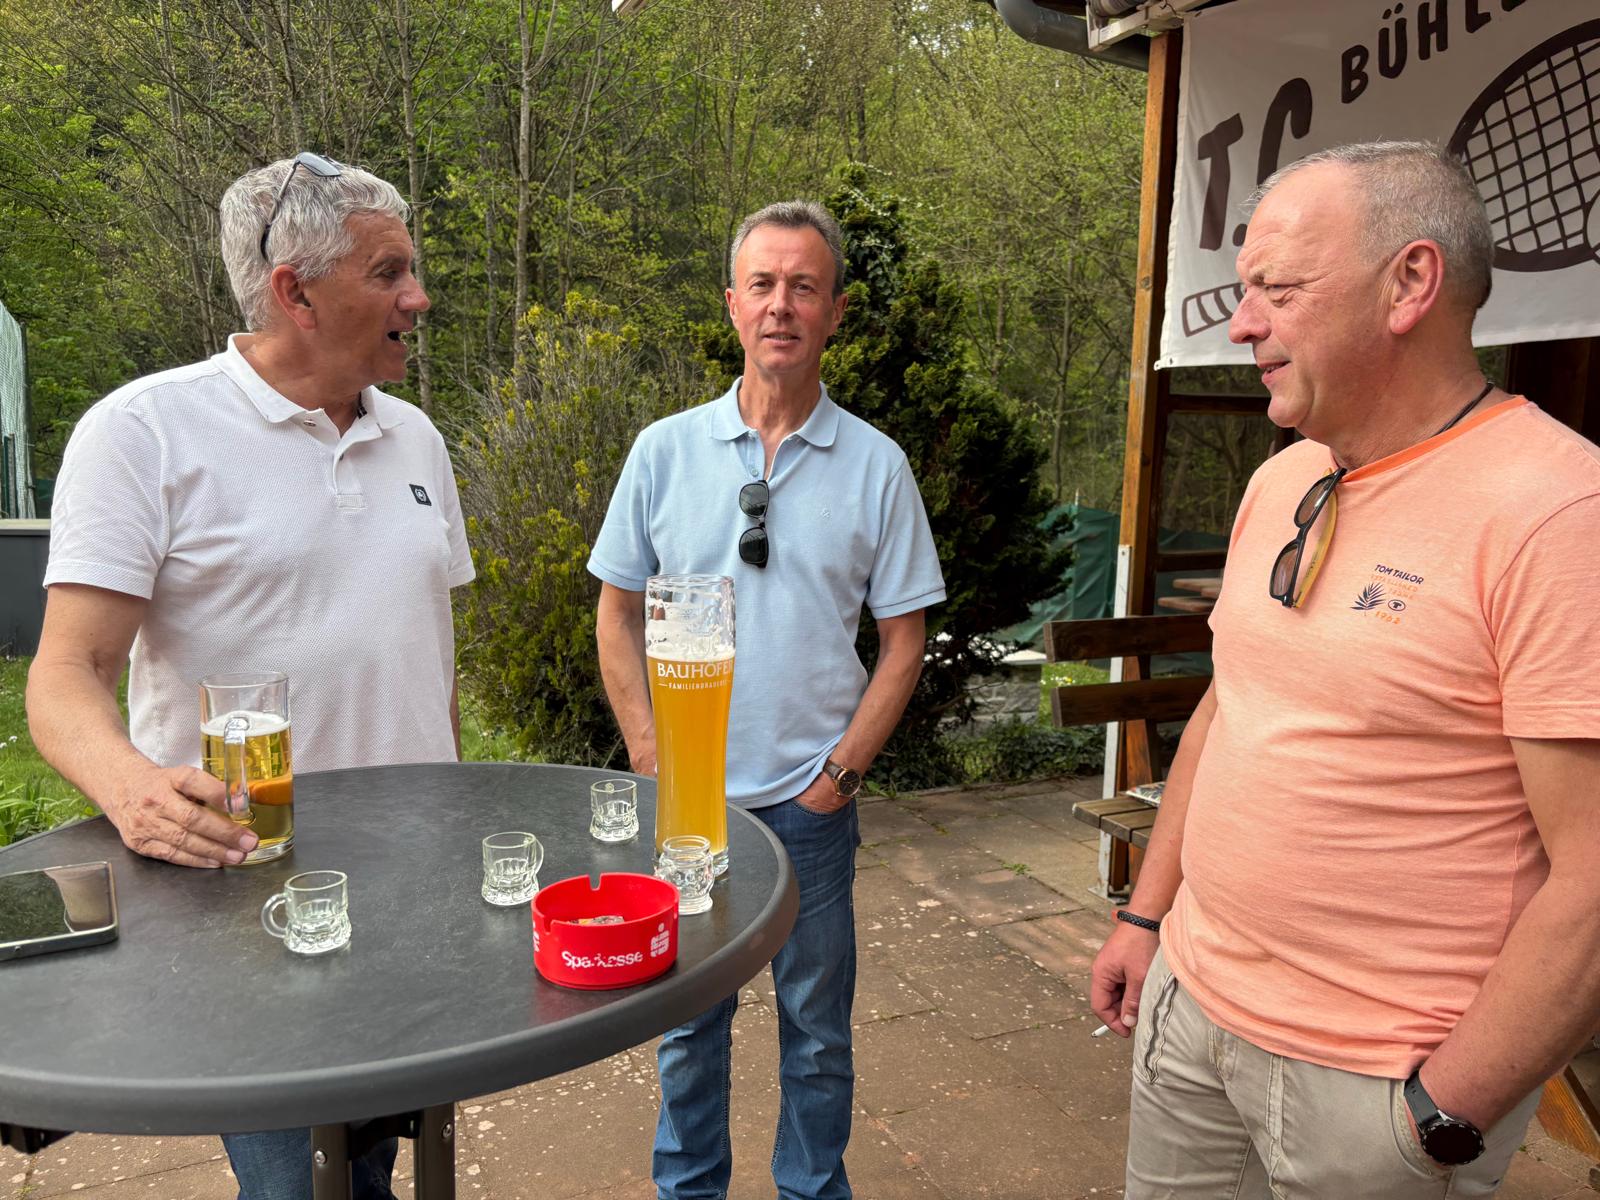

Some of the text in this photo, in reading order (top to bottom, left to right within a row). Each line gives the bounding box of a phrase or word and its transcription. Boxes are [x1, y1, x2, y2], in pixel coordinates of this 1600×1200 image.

[1341, 0, 1526, 104] BÜHL
[1375, 565, 1393, 574] TOM
[1393, 570, 1424, 584] TAILOR
